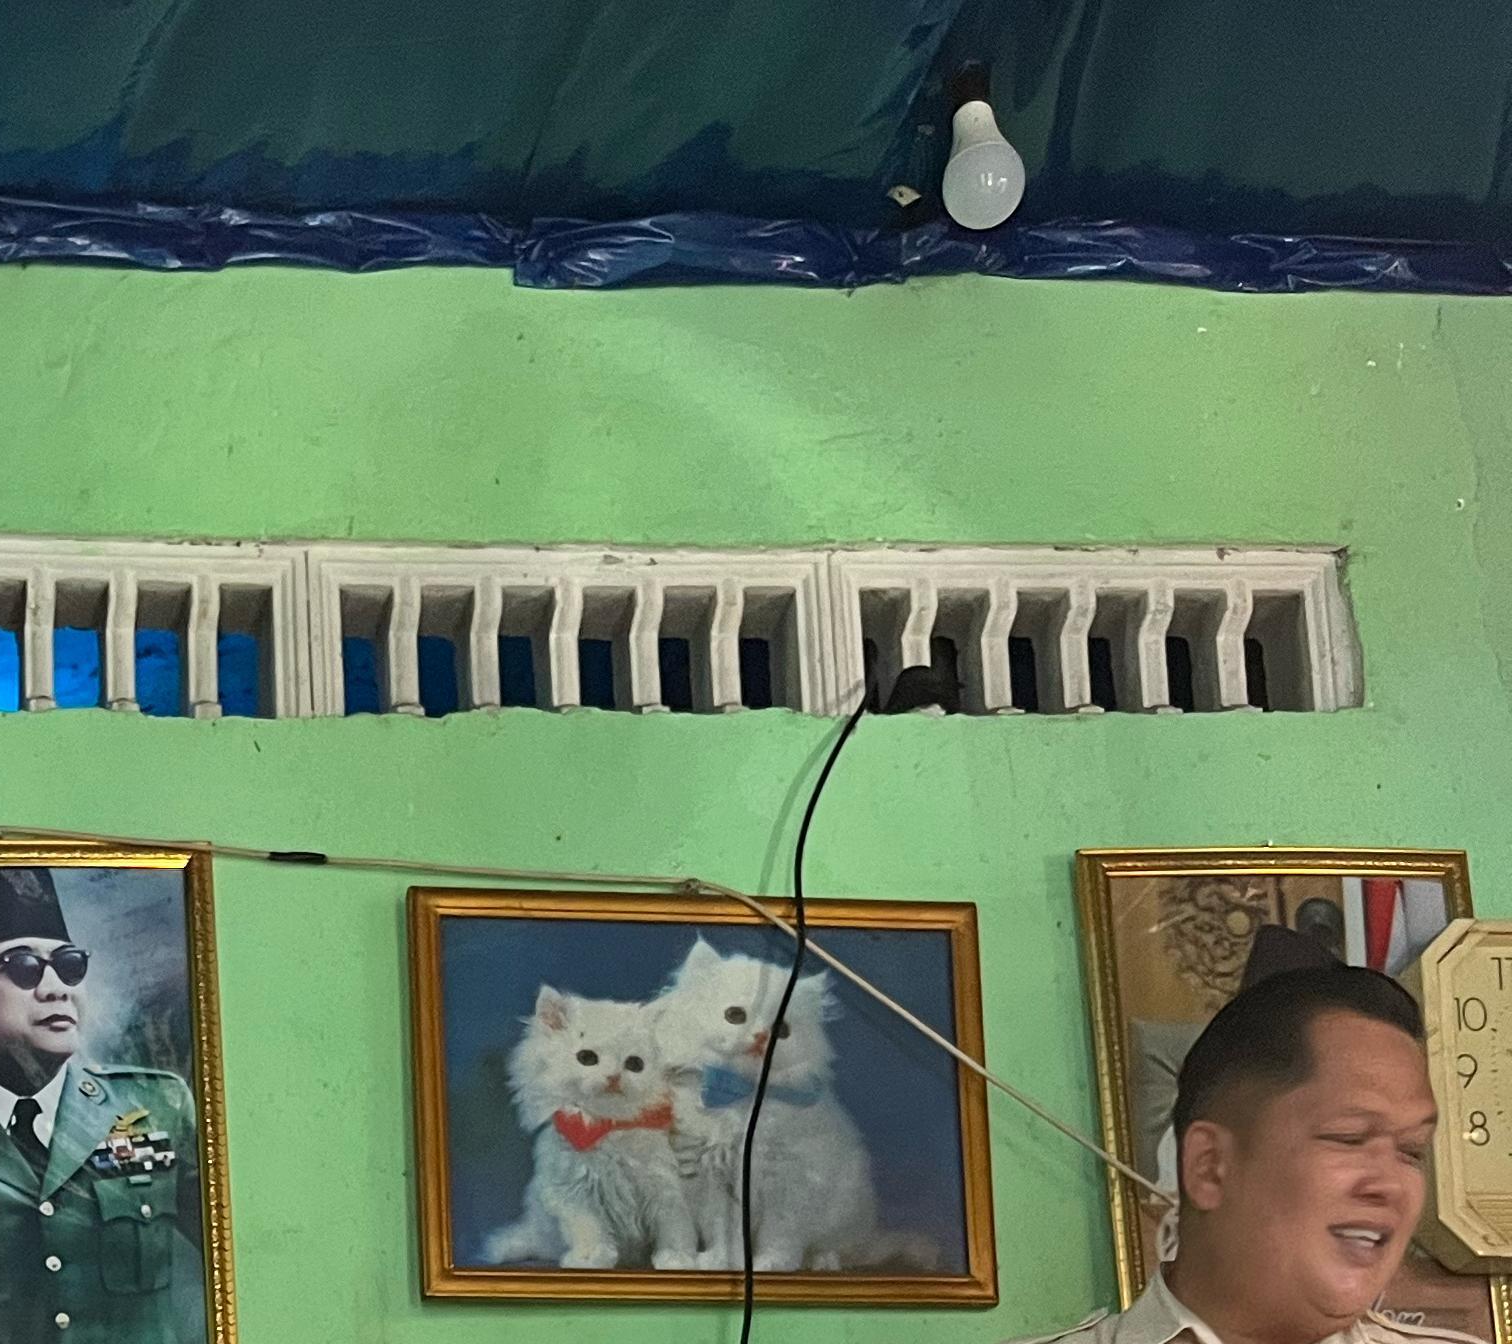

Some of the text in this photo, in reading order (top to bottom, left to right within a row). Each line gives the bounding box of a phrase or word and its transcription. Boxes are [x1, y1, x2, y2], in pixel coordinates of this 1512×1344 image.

[1453, 996, 1488, 1032] 10
[1456, 1053, 1478, 1089] 9
[1468, 1110, 1490, 1146] 8
